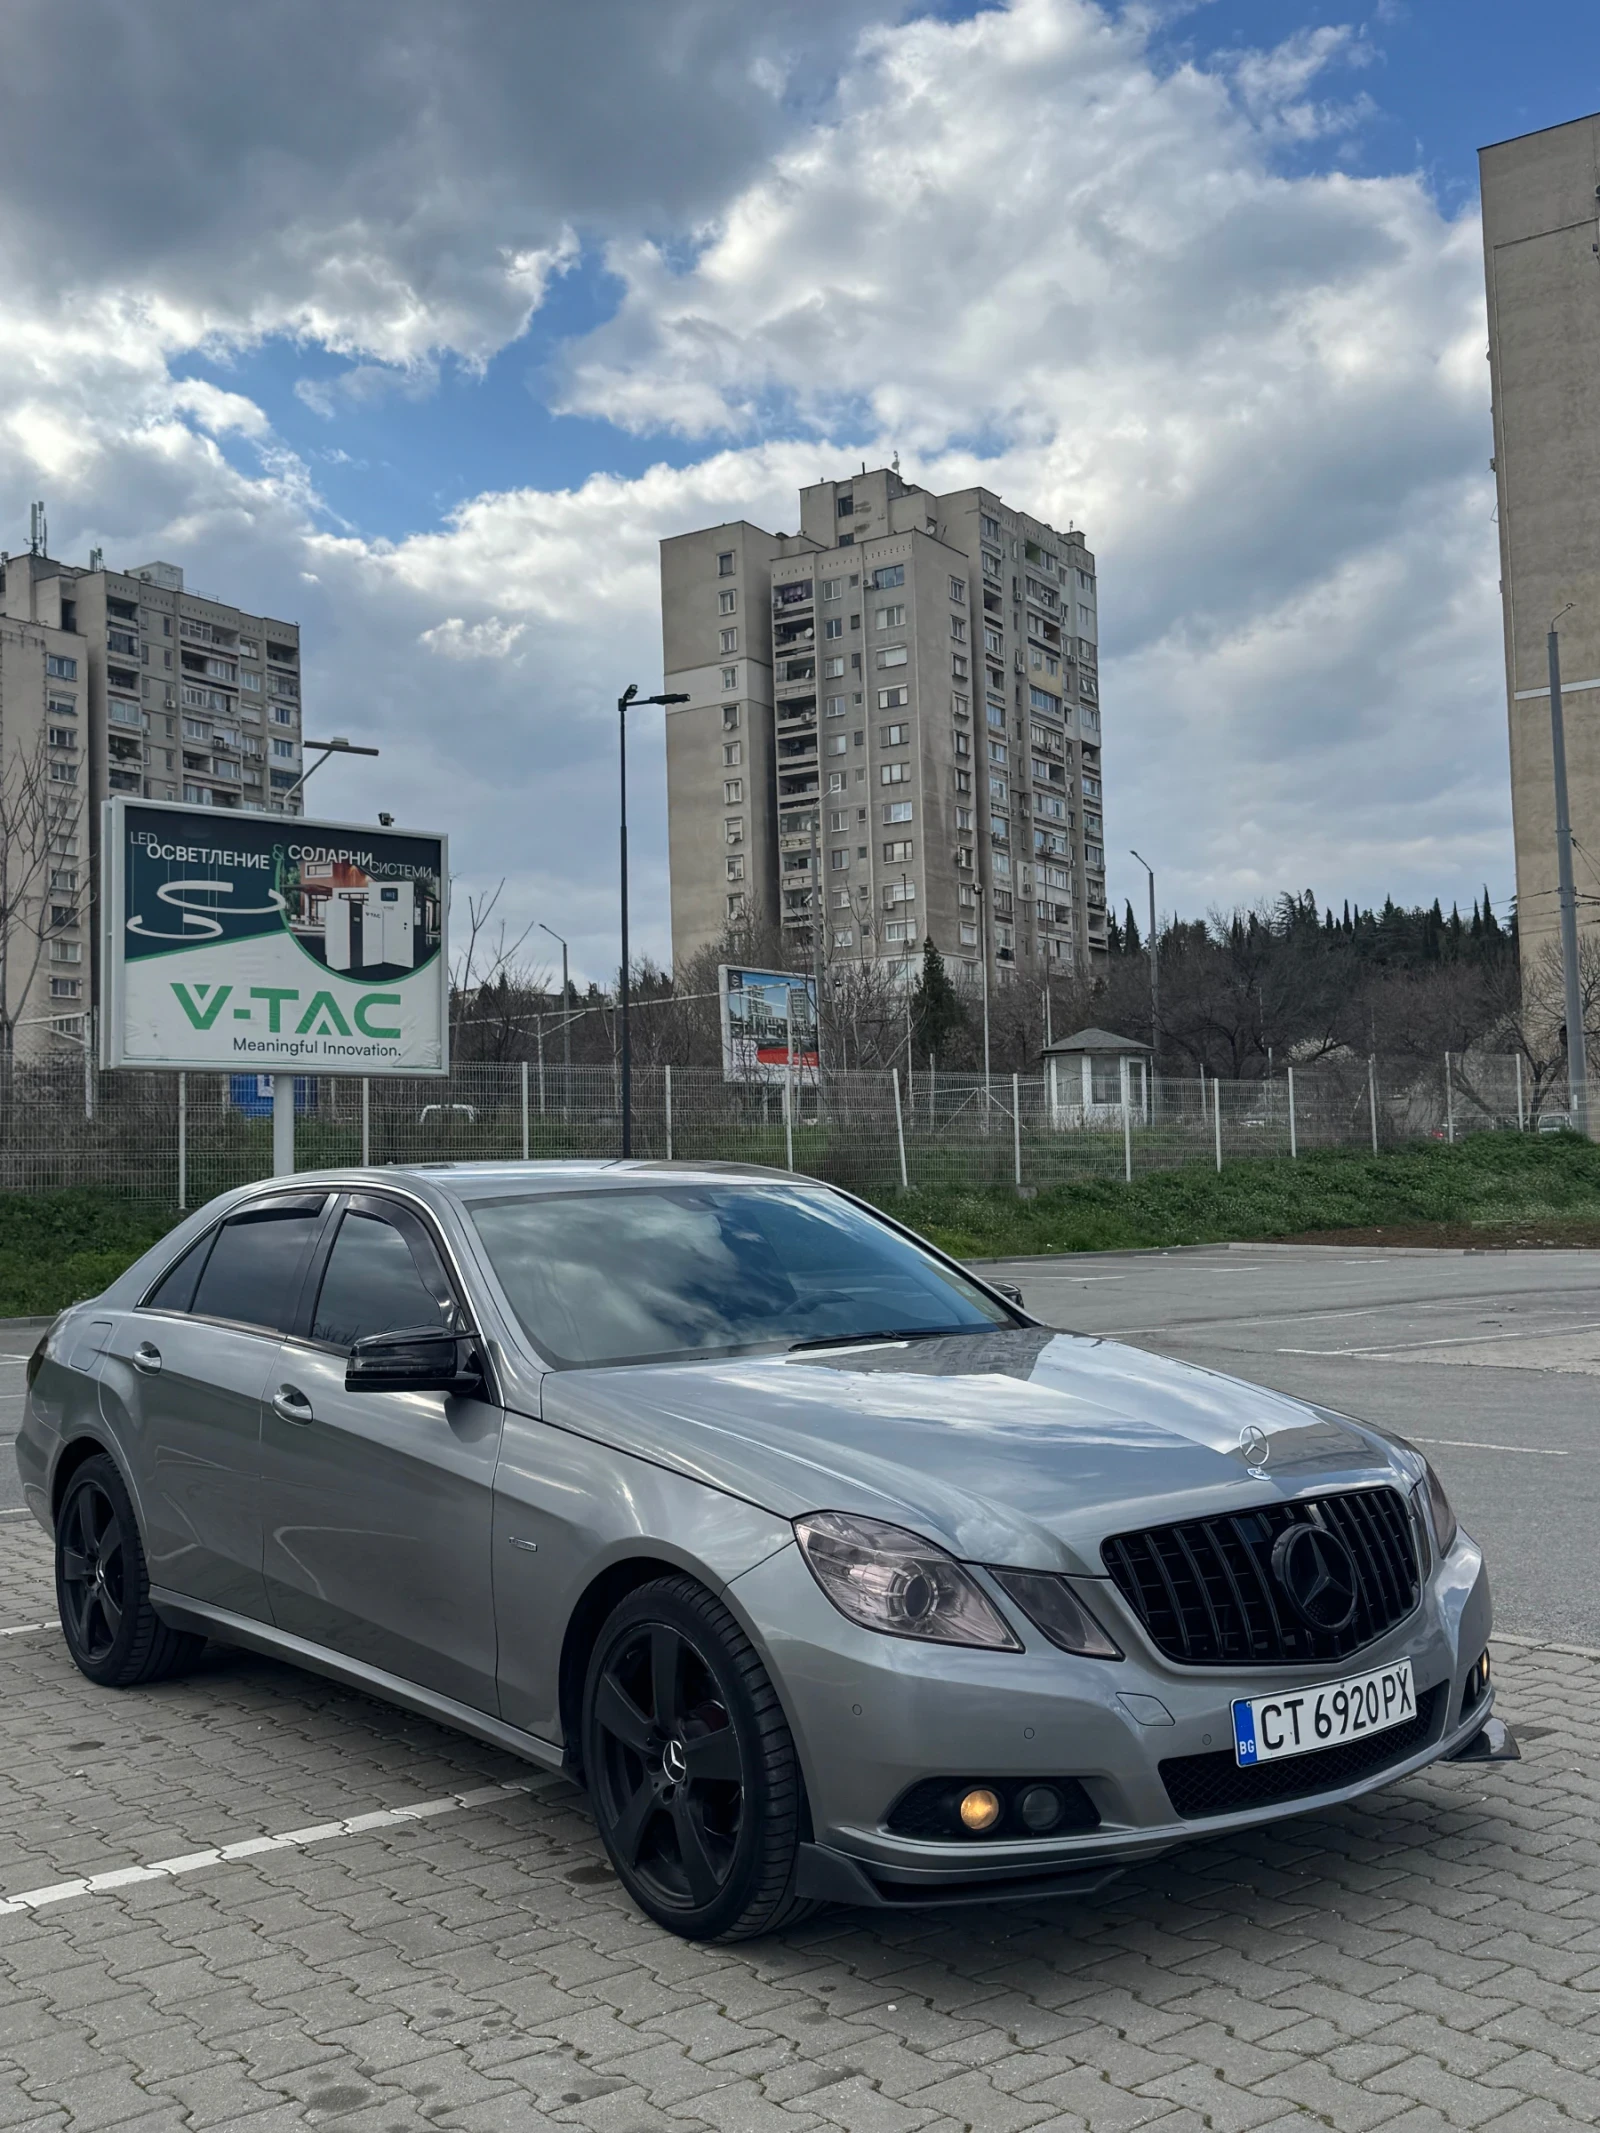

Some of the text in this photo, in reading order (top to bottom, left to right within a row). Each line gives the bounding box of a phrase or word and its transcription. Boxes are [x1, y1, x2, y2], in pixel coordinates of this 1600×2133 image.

[130, 831, 433, 879] LED ОСВЕТЛЕНИЕ & СОЛАРНИ СИСТЕМИ
[169, 982, 402, 1039] V-TAC
[233, 1037, 402, 1057] Meaningful Innovation.
[1239, 1739, 1255, 1755] BG
